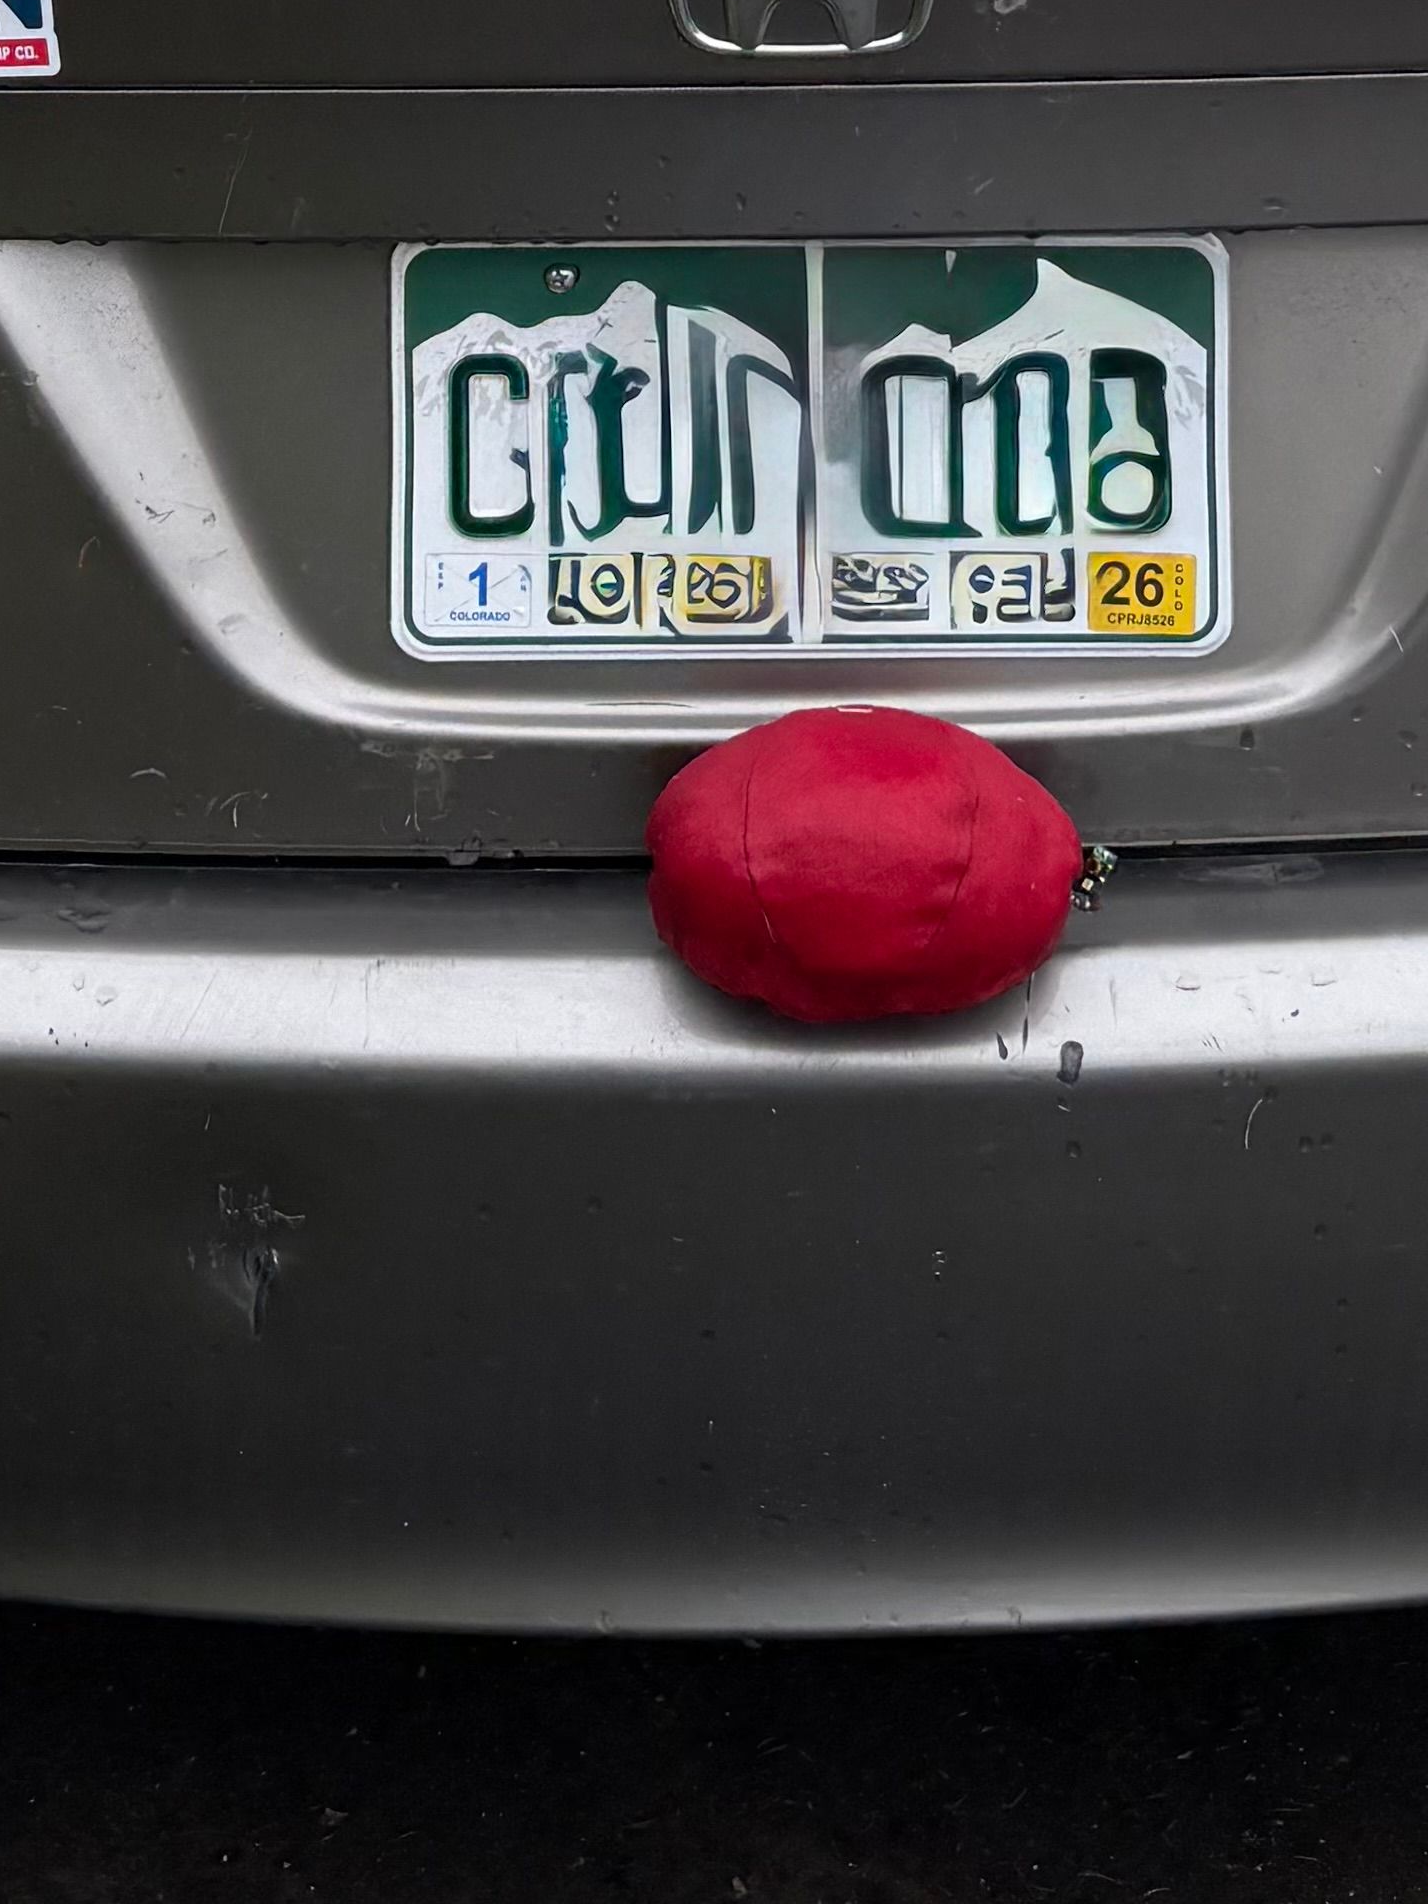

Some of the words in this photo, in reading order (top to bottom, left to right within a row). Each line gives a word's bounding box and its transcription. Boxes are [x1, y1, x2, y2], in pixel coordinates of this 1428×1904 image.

[15, 45, 40, 60] CO.
[469, 562, 488, 606] 1
[1095, 561, 1164, 607] 26
[449, 611, 510, 622] COLORADO
